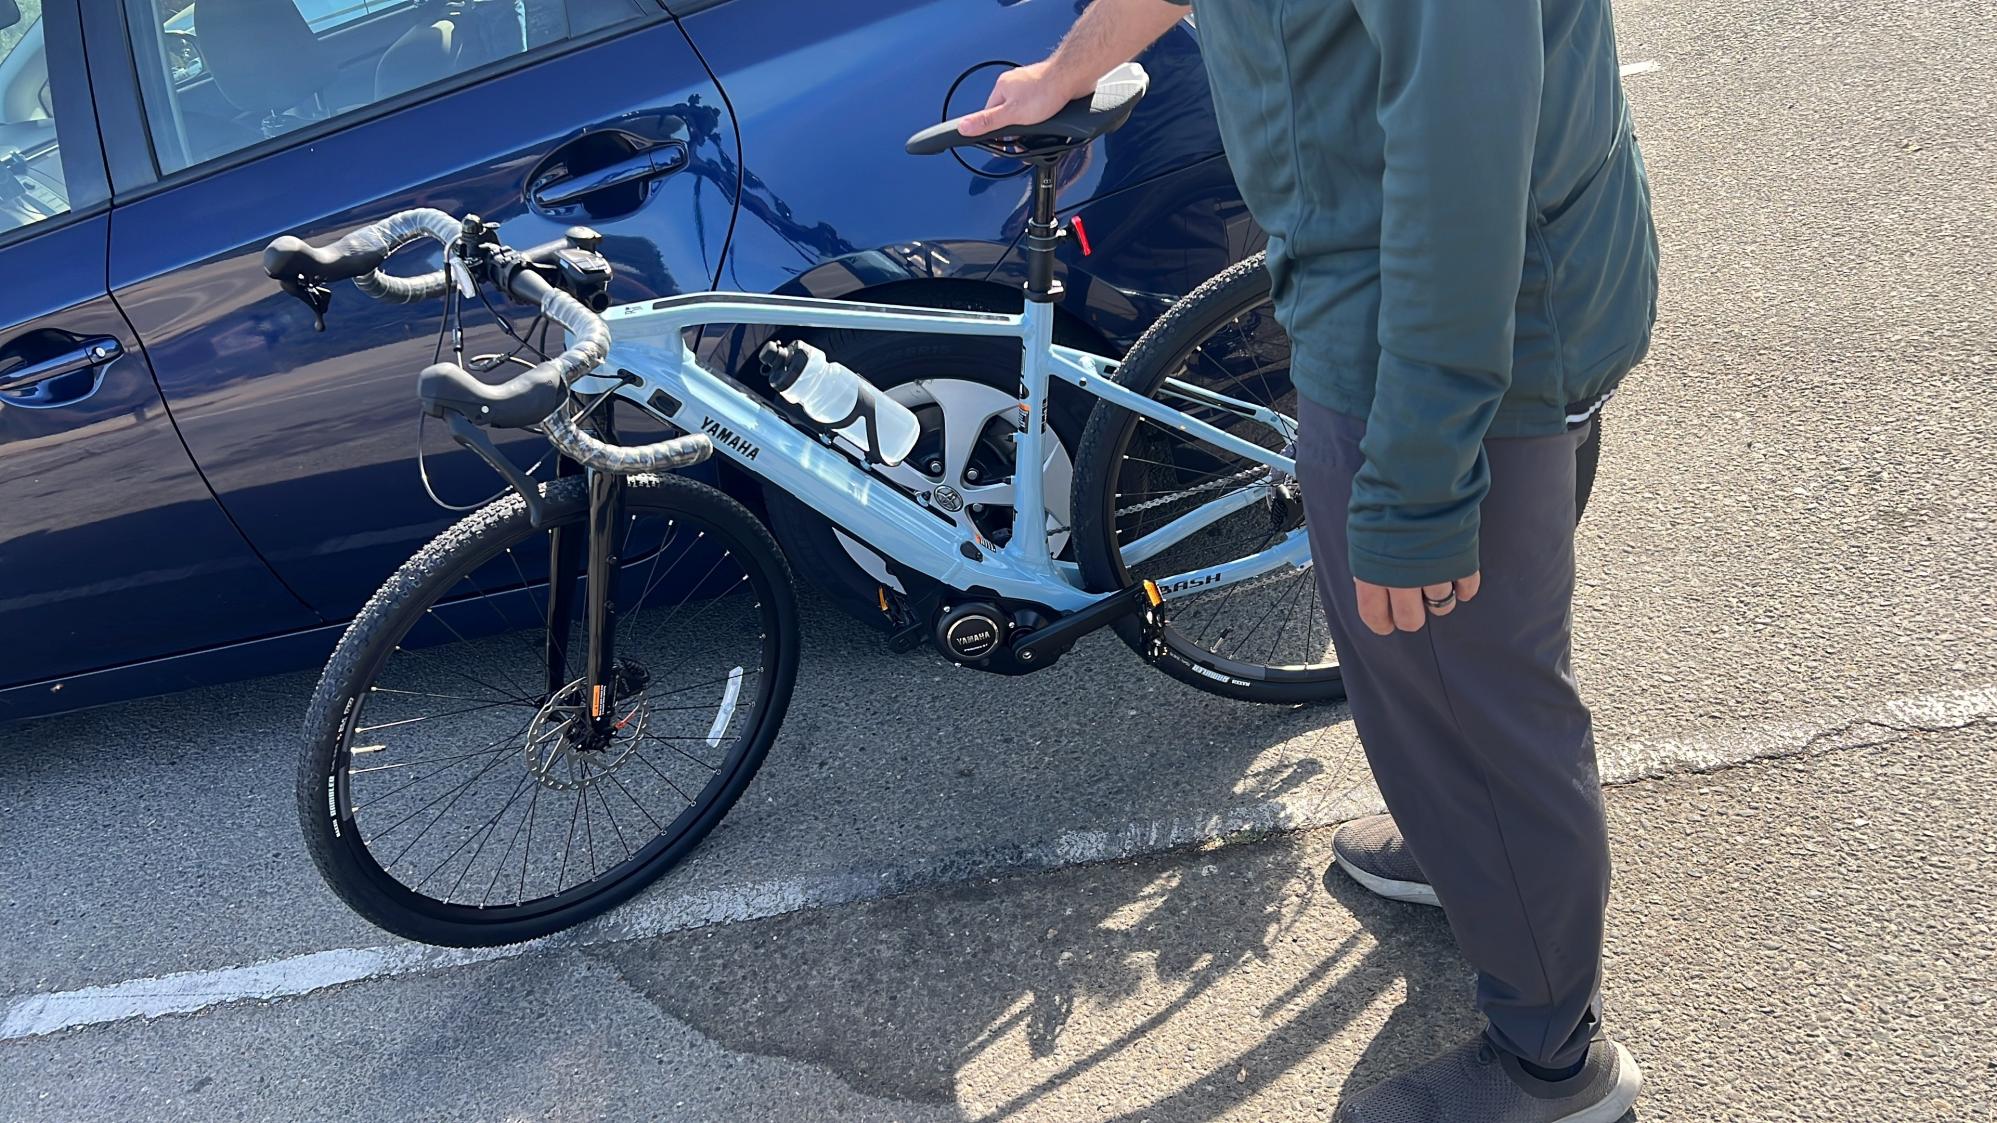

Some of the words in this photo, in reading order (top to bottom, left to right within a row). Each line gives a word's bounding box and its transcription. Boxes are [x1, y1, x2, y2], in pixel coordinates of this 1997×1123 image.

[701, 416, 760, 461] YAMAHA
[1160, 573, 1222, 595] BASH
[956, 631, 990, 645] YAMAHA
